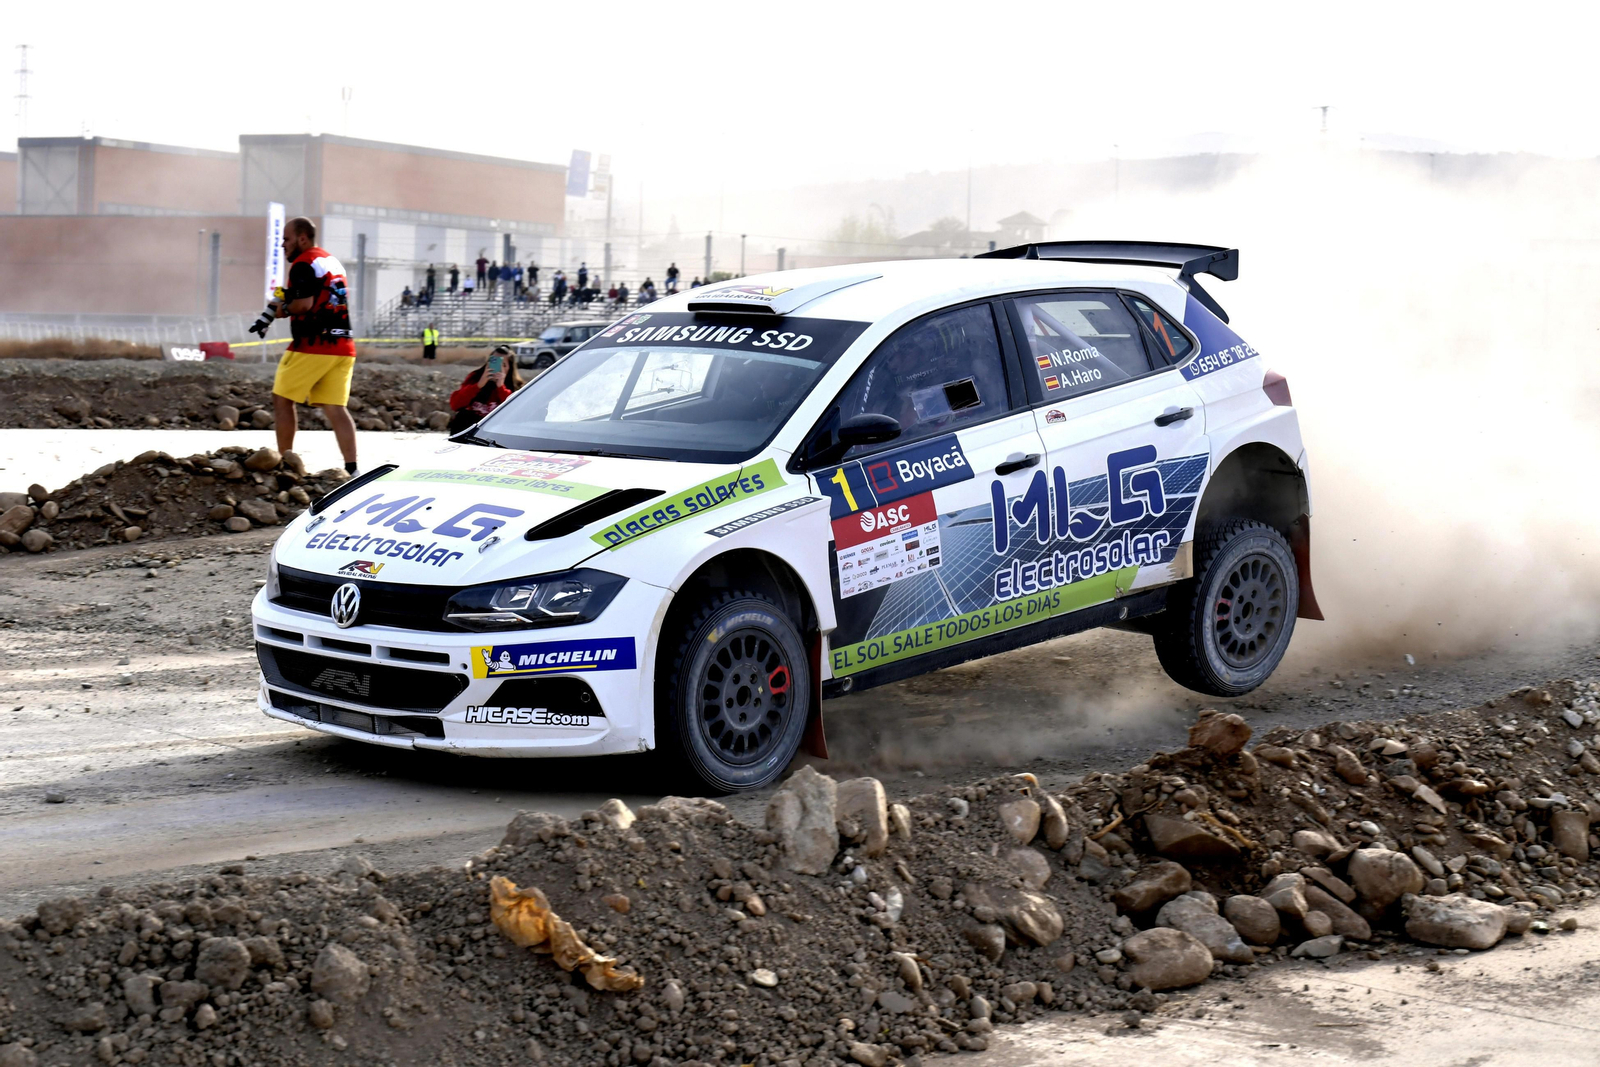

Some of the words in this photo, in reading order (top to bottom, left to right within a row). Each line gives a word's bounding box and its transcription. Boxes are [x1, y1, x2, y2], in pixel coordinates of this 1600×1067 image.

[616, 325, 754, 344] SAMSUNG
[752, 330, 814, 351] SSD
[1153, 312, 1176, 357] 1
[1050, 345, 1100, 368] N.Roma
[1198, 354, 1221, 373] 654
[1218, 349, 1233, 366] 85
[1230, 344, 1246, 360] 78
[1060, 367, 1102, 389] A.Haro
[896, 445, 966, 483] Boyacá
[831, 467, 859, 512] 1
[990, 444, 1167, 556] MLG
[333, 493, 525, 542] MLG
[714, 507, 786, 535] SAMSUNG
[877, 504, 910, 529] ASC
[833, 652, 853, 671] EL
[857, 642, 889, 664] SOL
[893, 627, 933, 653] SALE
[936, 614, 990, 642] TODOS
[994, 602, 1023, 626] LOS
[1027, 591, 1061, 616] DIAS
[518, 649, 617, 666] MICHELIN
